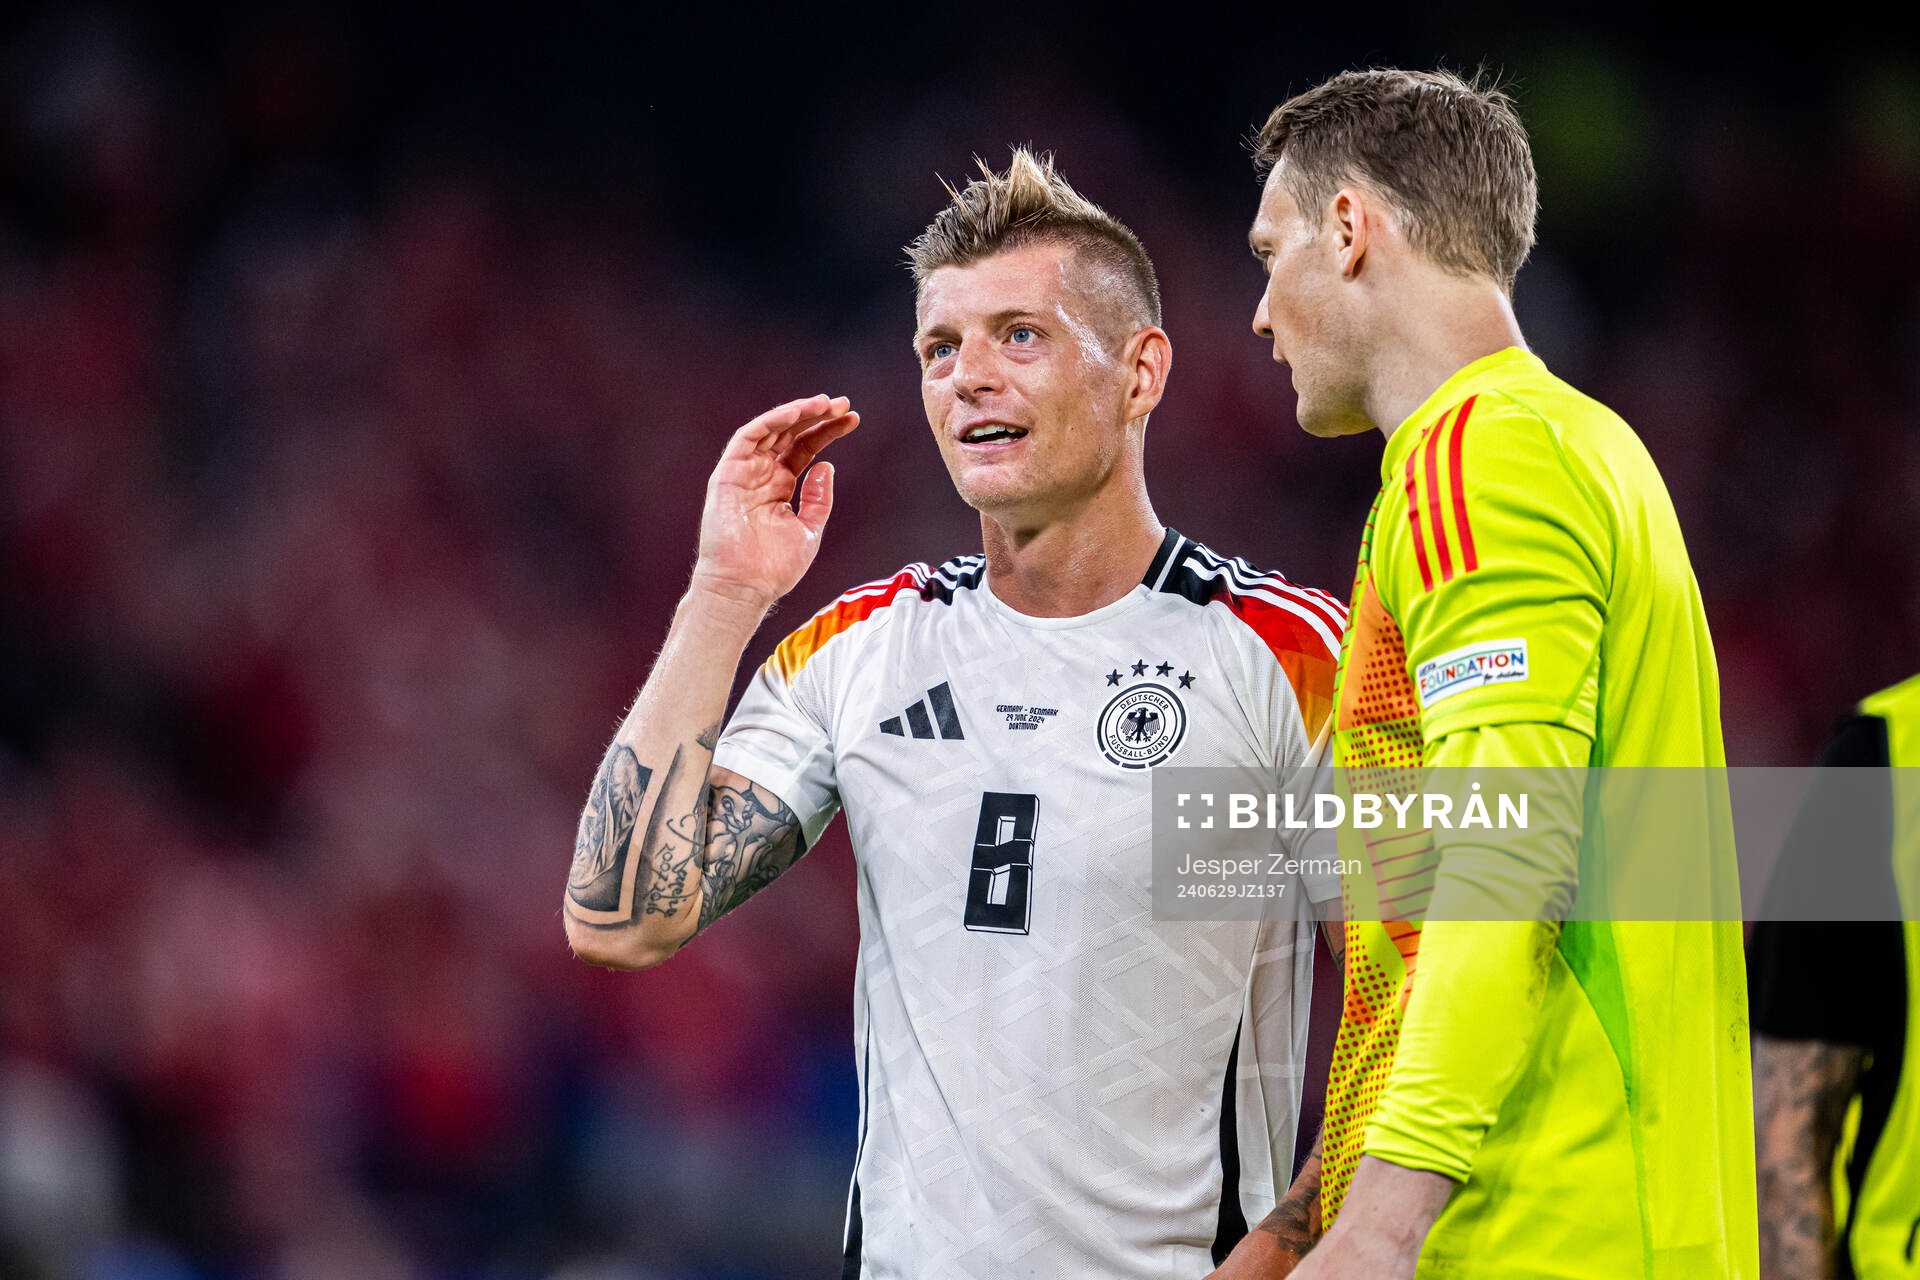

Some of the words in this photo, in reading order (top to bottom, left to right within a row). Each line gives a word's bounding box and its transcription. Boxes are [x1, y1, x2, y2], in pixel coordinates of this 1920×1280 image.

[1420, 652, 1524, 693] FOUNDATION
[996, 704, 1023, 713] GERMANY
[1029, 707, 1058, 716] DENMARK
[1120, 694, 1169, 711] DEUTSCHER
[1005, 713, 1013, 722] 29
[1014, 713, 1028, 722] JUNE
[1028, 715, 1045, 724] 2024
[1009, 722, 1039, 730] DORTMUND
[1109, 734, 1169, 758] FUSSBALL-BUND
[964, 792, 1040, 935] 8
